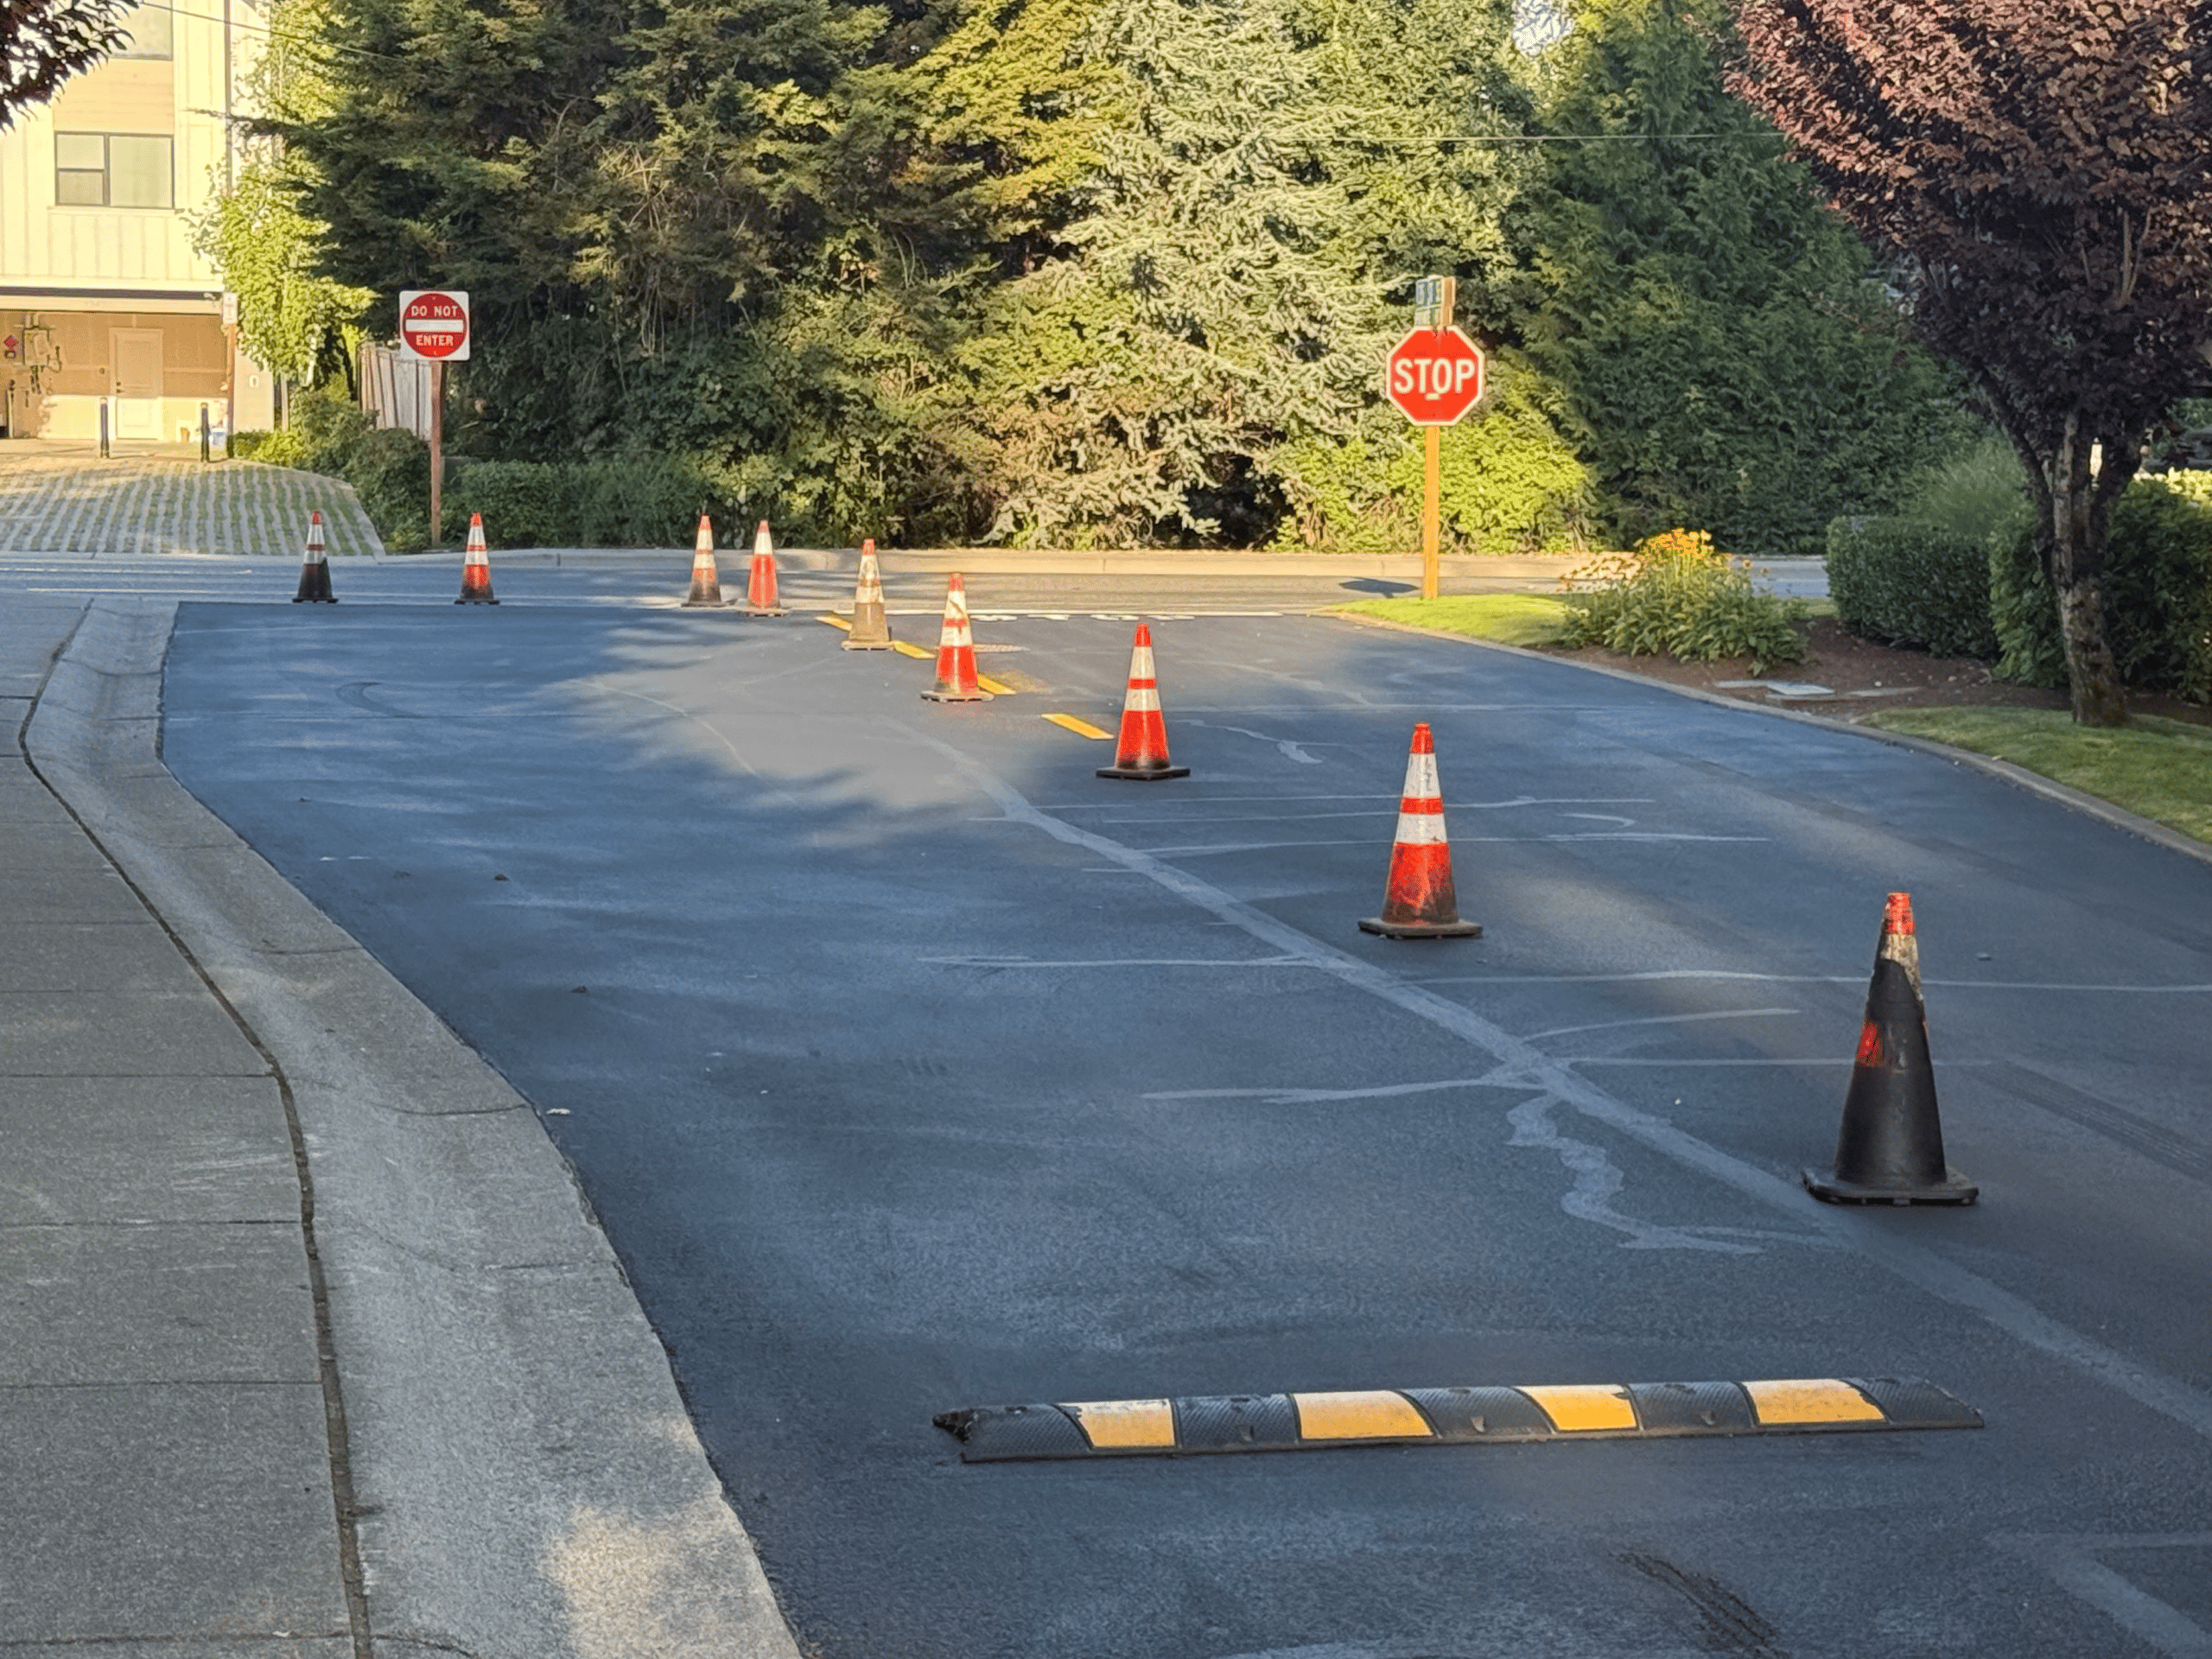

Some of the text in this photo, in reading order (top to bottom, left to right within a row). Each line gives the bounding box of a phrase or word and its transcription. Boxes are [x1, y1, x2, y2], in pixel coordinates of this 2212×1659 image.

[411, 305, 458, 317] DO NOT
[416, 334, 454, 346] ENTER
[1395, 359, 1475, 393] STOP
